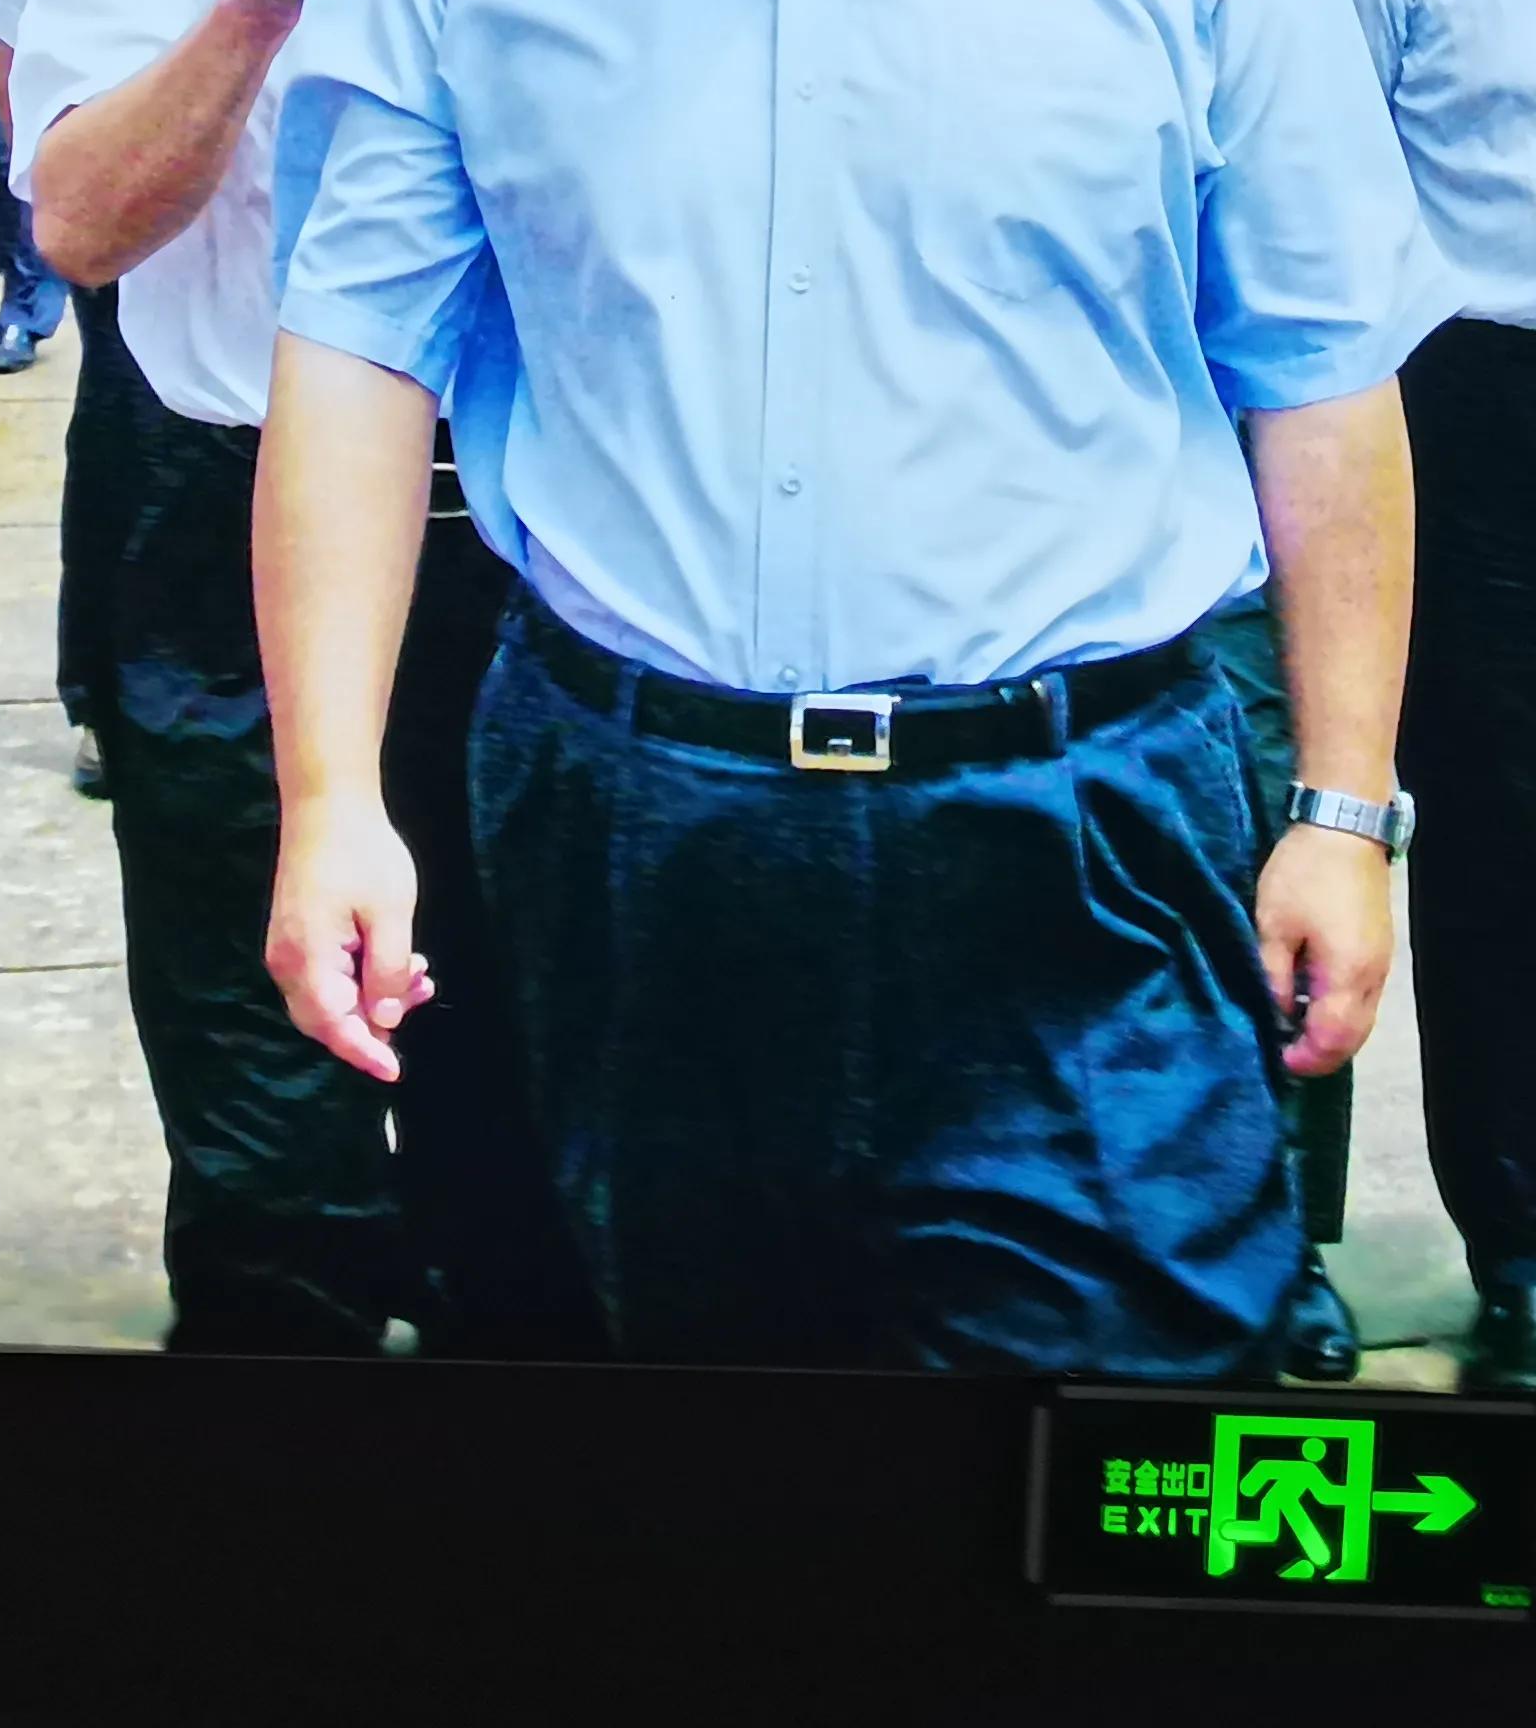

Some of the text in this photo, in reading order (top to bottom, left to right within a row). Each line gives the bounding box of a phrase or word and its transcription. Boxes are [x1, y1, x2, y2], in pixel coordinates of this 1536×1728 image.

[1103, 1458, 1211, 1497] 安全出口
[1102, 1505, 1209, 1536] EXIT
